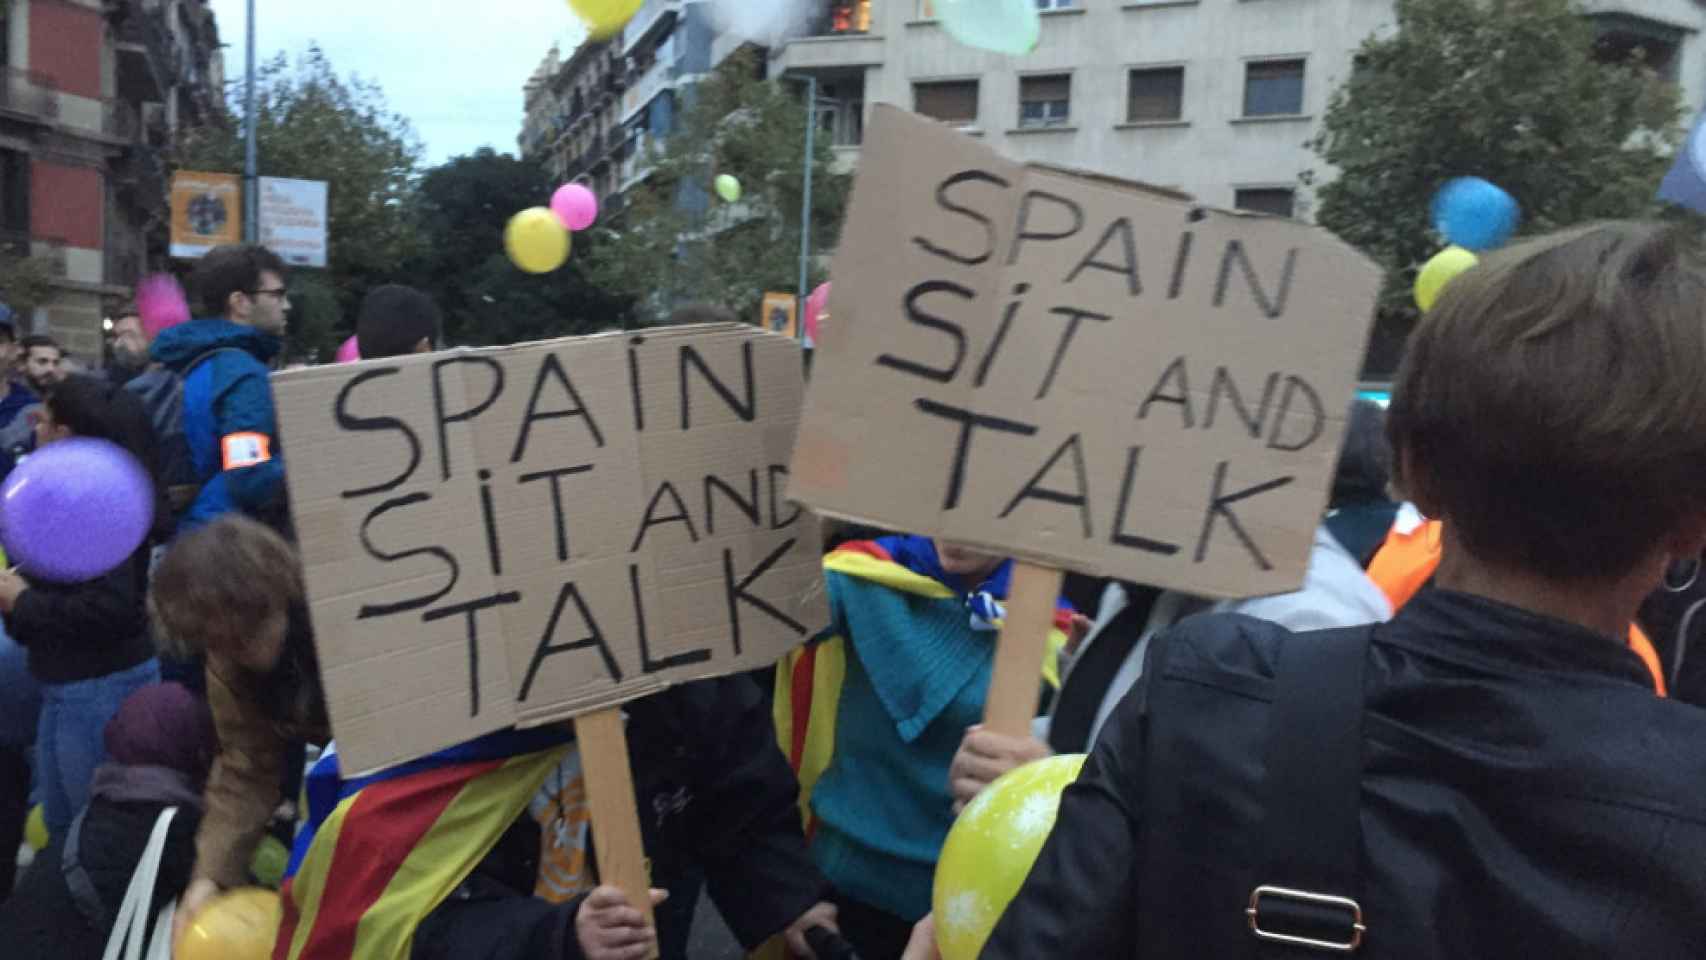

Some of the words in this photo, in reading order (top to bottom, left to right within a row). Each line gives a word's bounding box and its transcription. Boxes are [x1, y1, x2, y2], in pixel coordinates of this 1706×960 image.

[914, 398, 1294, 571] TALK
[1136, 355, 1327, 453] AND
[422, 537, 809, 719] TALK
